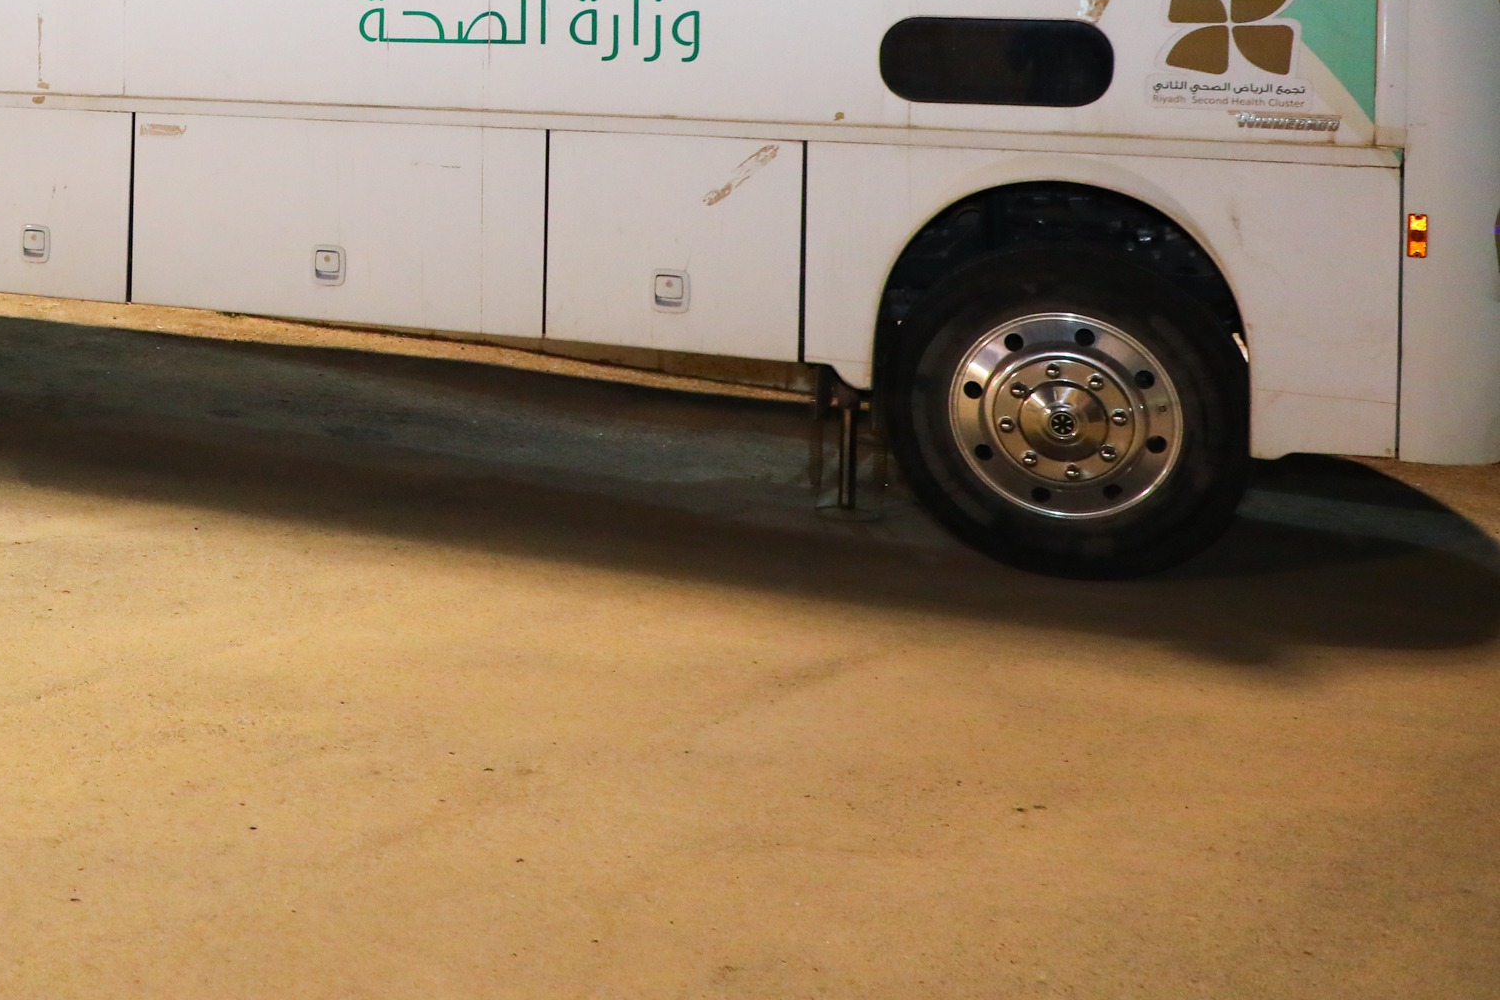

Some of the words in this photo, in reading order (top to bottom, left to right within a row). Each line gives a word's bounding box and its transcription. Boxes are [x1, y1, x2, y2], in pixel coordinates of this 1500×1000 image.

[1153, 81, 1187, 93] الثاني
[1189, 82, 1231, 95] الصحي
[1233, 83, 1273, 94] الرياض
[1275, 83, 1306, 96] تجمع
[1153, 94, 1187, 104] Riyadh
[1191, 95, 1229, 105] Second
[1231, 96, 1266, 106] Health
[1268, 98, 1305, 108] Cluster
